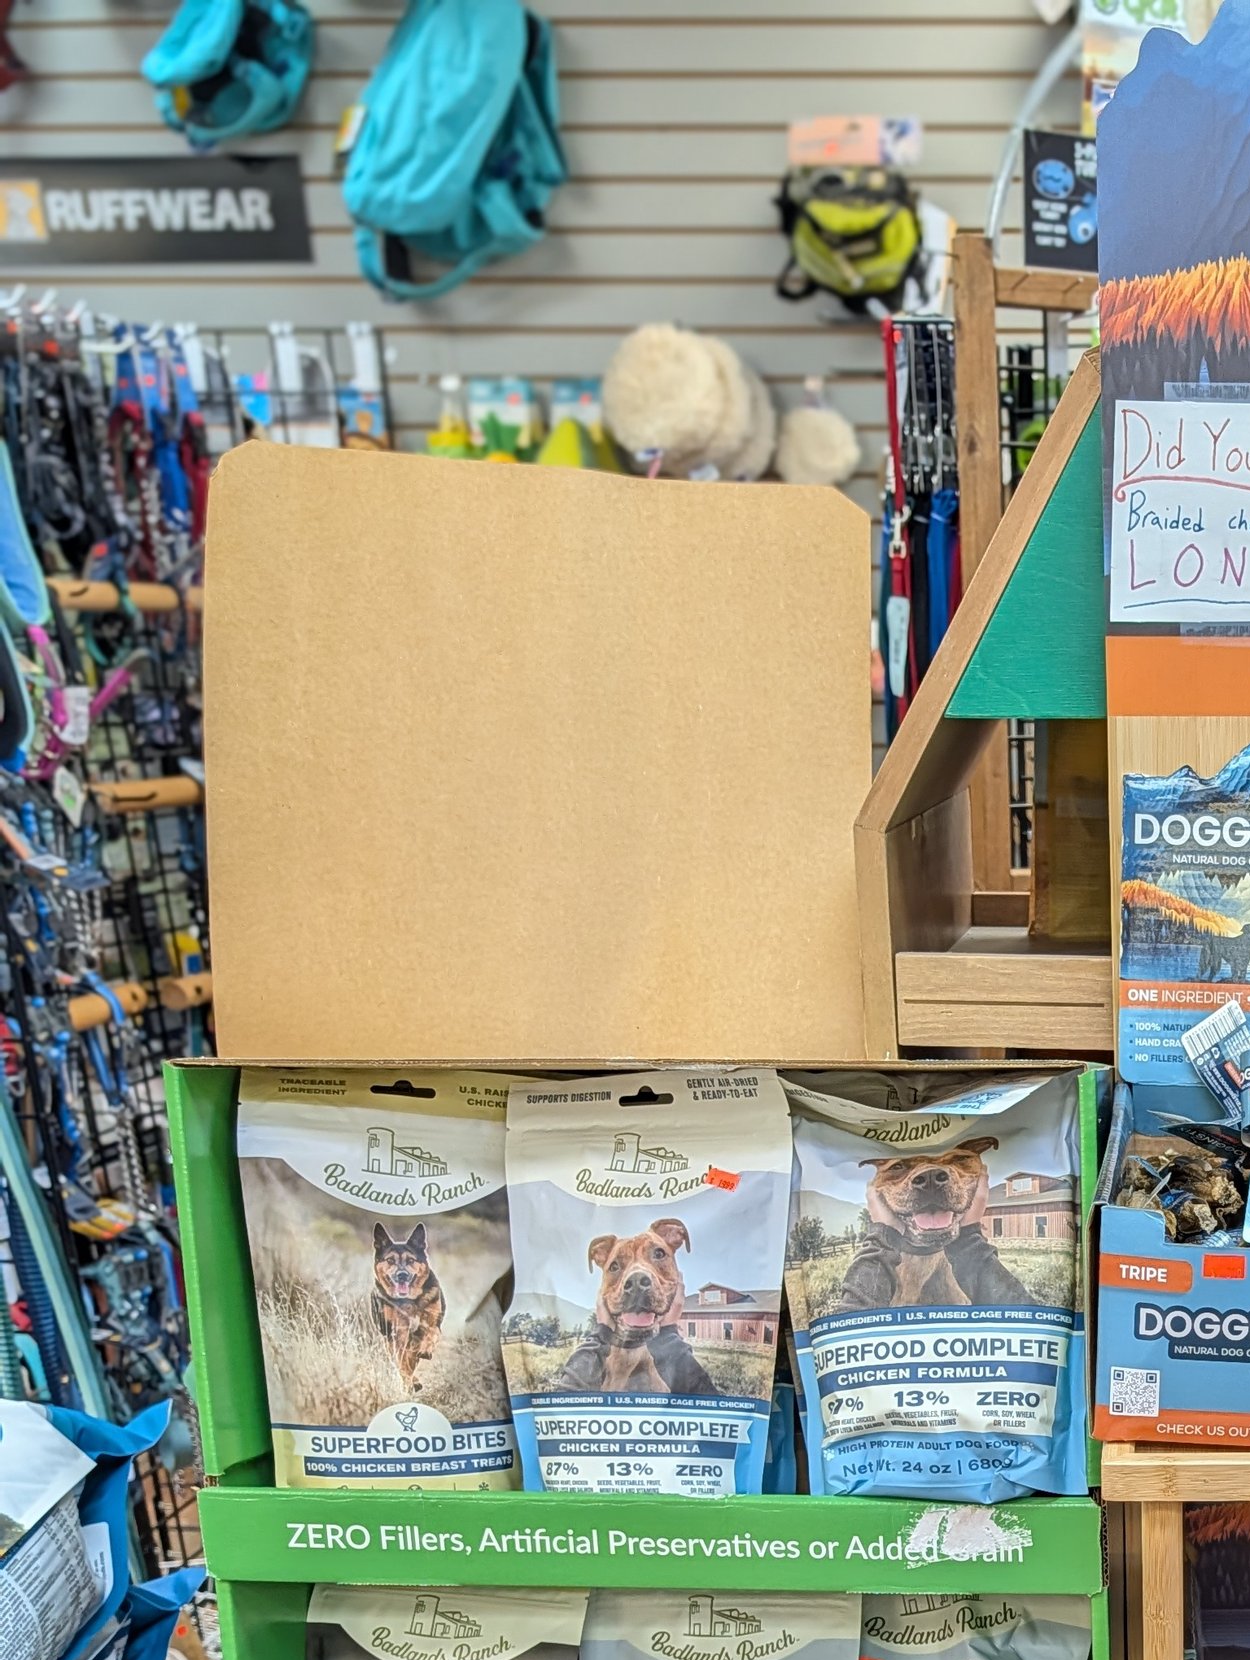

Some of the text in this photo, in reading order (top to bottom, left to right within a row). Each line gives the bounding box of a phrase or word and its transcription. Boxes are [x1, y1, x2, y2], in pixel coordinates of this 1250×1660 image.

[46, 190, 274, 234] RUFFWEAR
[1121, 408, 1188, 482] Did
[1126, 490, 1206, 538] Braided
[323, 1163, 486, 1208] Badlands Ranch
[1119, 1264, 1168, 1283] TRIPE
[932, 1337, 1060, 1362] COMPLETE
[837, 1365, 1008, 1387] CHICKEN FORMULA
[976, 1391, 1041, 1408] ZERO
[310, 1430, 506, 1455] SUPERFOOD BITES
[305, 1454, 512, 1473] 100% CHICKEN BREAST TREATS
[287, 1524, 371, 1550] ZERO
[380, 1525, 472, 1556] Fillers,
[479, 1528, 599, 1556] Artificial
[608, 1531, 801, 1563] Preservatives
[809, 1541, 840, 1561] or
